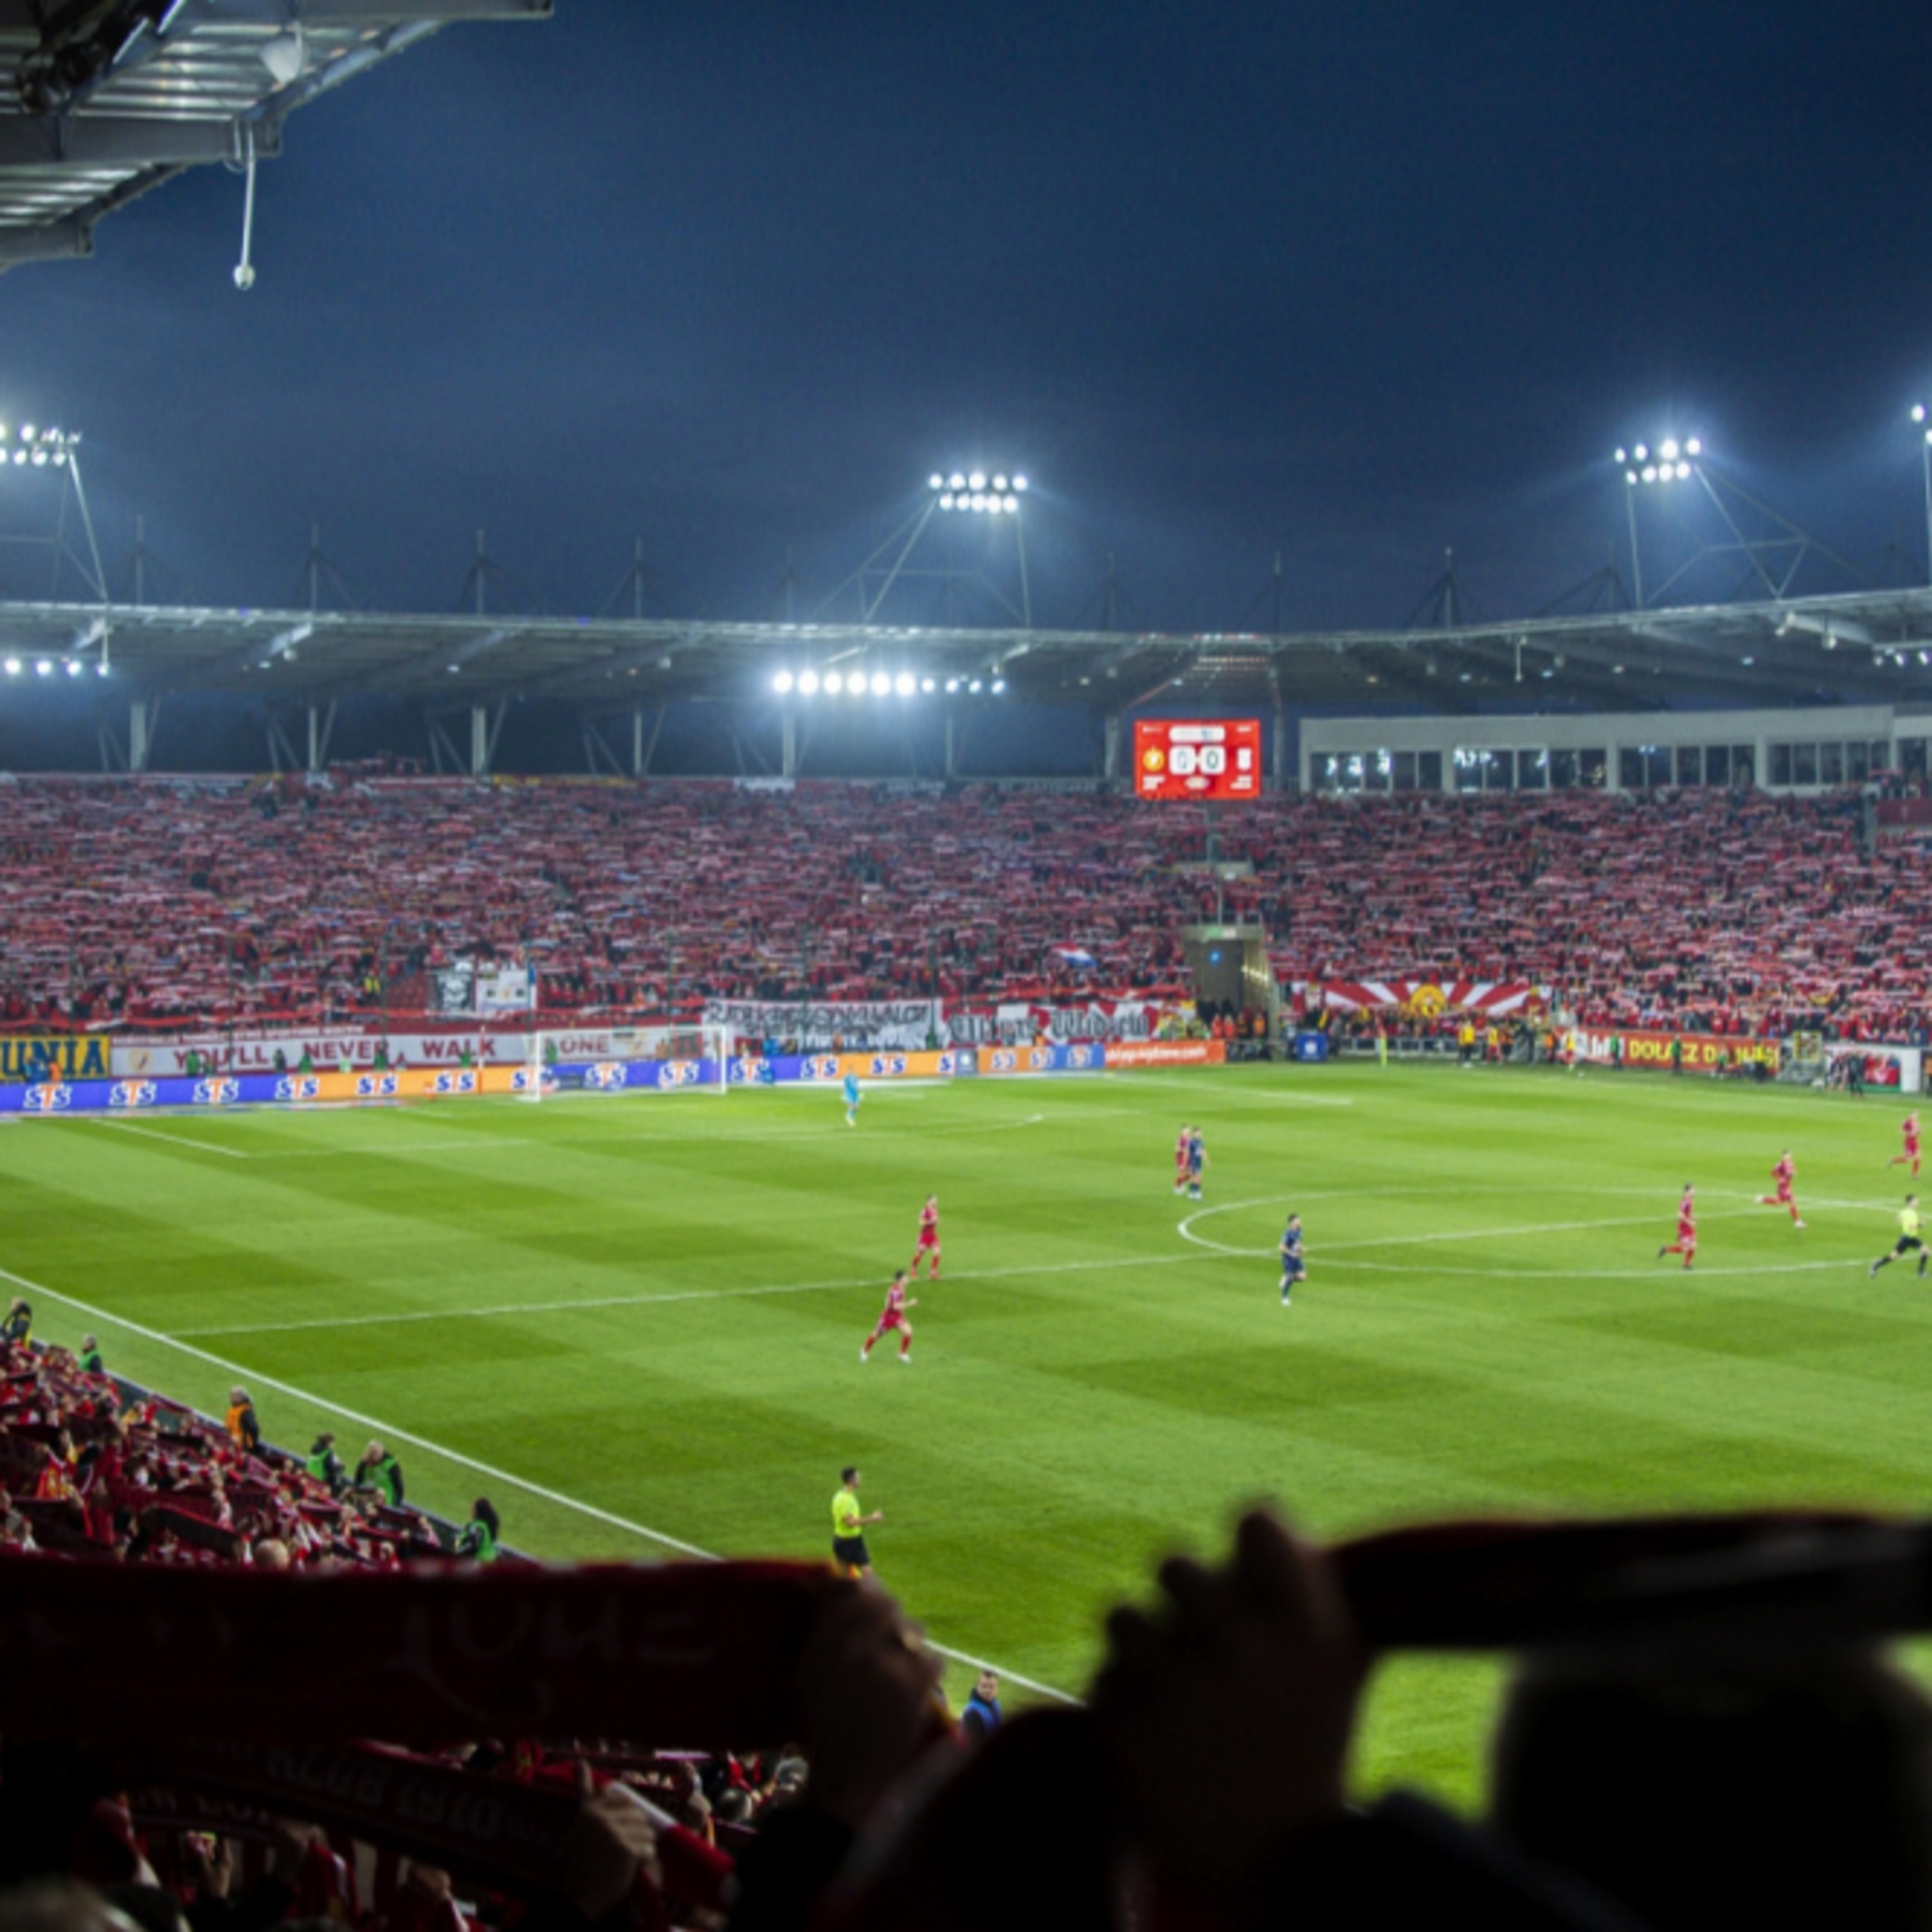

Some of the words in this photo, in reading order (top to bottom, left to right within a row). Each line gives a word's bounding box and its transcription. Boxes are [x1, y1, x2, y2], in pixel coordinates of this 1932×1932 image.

[422, 1038, 495, 1059] WALK
[584, 1063, 627, 1088] STS
[658, 1060, 699, 1087] STS
[800, 1056, 838, 1080] STS
[871, 1054, 906, 1075] STS
[109, 1079, 157, 1107] STS
[194, 1077, 239, 1104] STS
[275, 1075, 319, 1100] STS
[357, 1072, 397, 1096] STS
[436, 1070, 474, 1093] STS
[23, 1082, 72, 1110] STS
